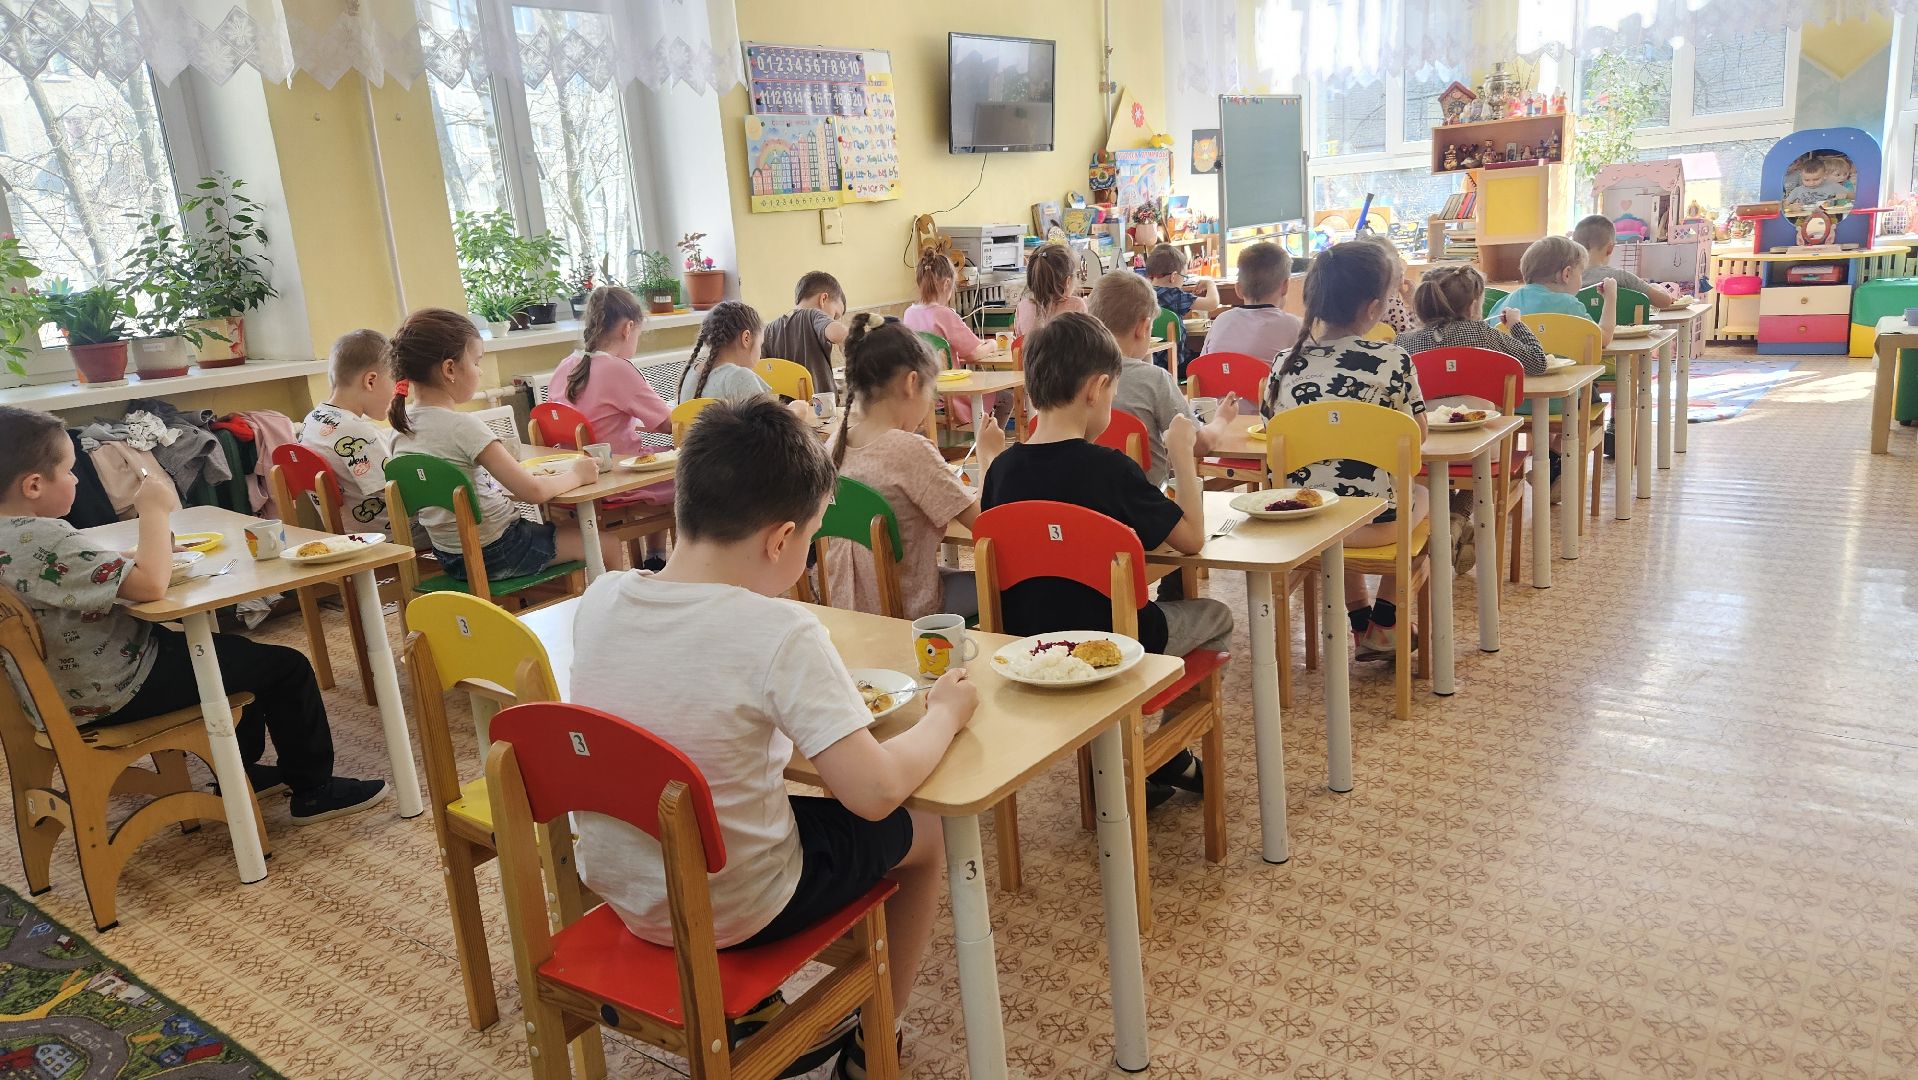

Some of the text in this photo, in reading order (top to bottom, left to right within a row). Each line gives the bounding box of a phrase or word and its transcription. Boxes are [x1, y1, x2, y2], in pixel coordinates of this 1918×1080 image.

[757, 55, 859, 75] 0 1 2 3 4 5 6 7 8 9 10
[760, 90, 770, 105] 11
[770, 90, 783, 105] 12
[782, 90, 793, 105] 13
[793, 91, 803, 105] 14
[813, 92, 823, 106] 16
[834, 92, 843, 106] 18
[852, 93, 863, 107] 20
[1540, 324, 1545, 332] 3
[1331, 412, 1339, 423] 3
[587, 519, 594, 530] 3
[1051, 526, 1060, 539] 3
[1261, 604, 1269, 617] 3
[460, 618, 469, 634] 3
[195, 644, 204, 657] 3
[574, 734, 586, 753] 3
[965, 860, 977, 880] 3
